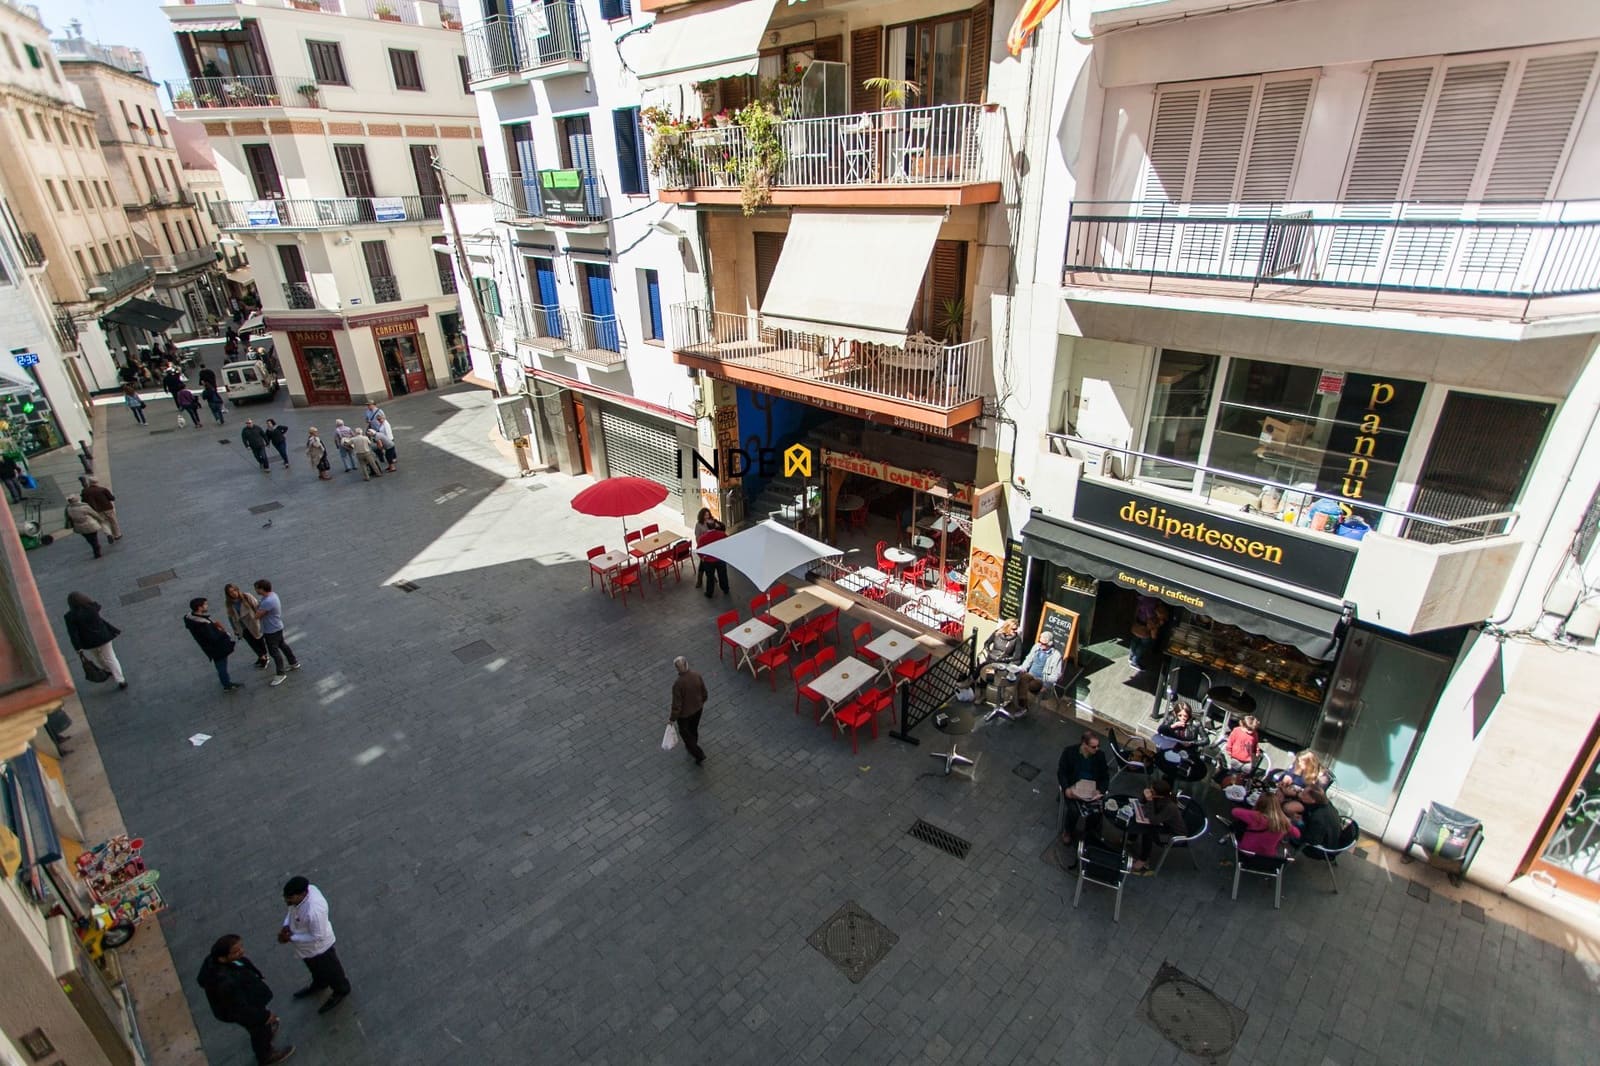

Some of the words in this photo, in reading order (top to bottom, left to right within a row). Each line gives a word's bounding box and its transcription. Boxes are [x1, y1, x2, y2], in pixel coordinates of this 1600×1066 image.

[374, 322, 416, 335] CONFITERIA
[1119, 500, 1284, 565] delipatessen
[1118, 571, 1136, 585] forn
[1136, 577, 1148, 589] de
[1148, 583, 1159, 593] pa
[1160, 584, 1165, 594] i
